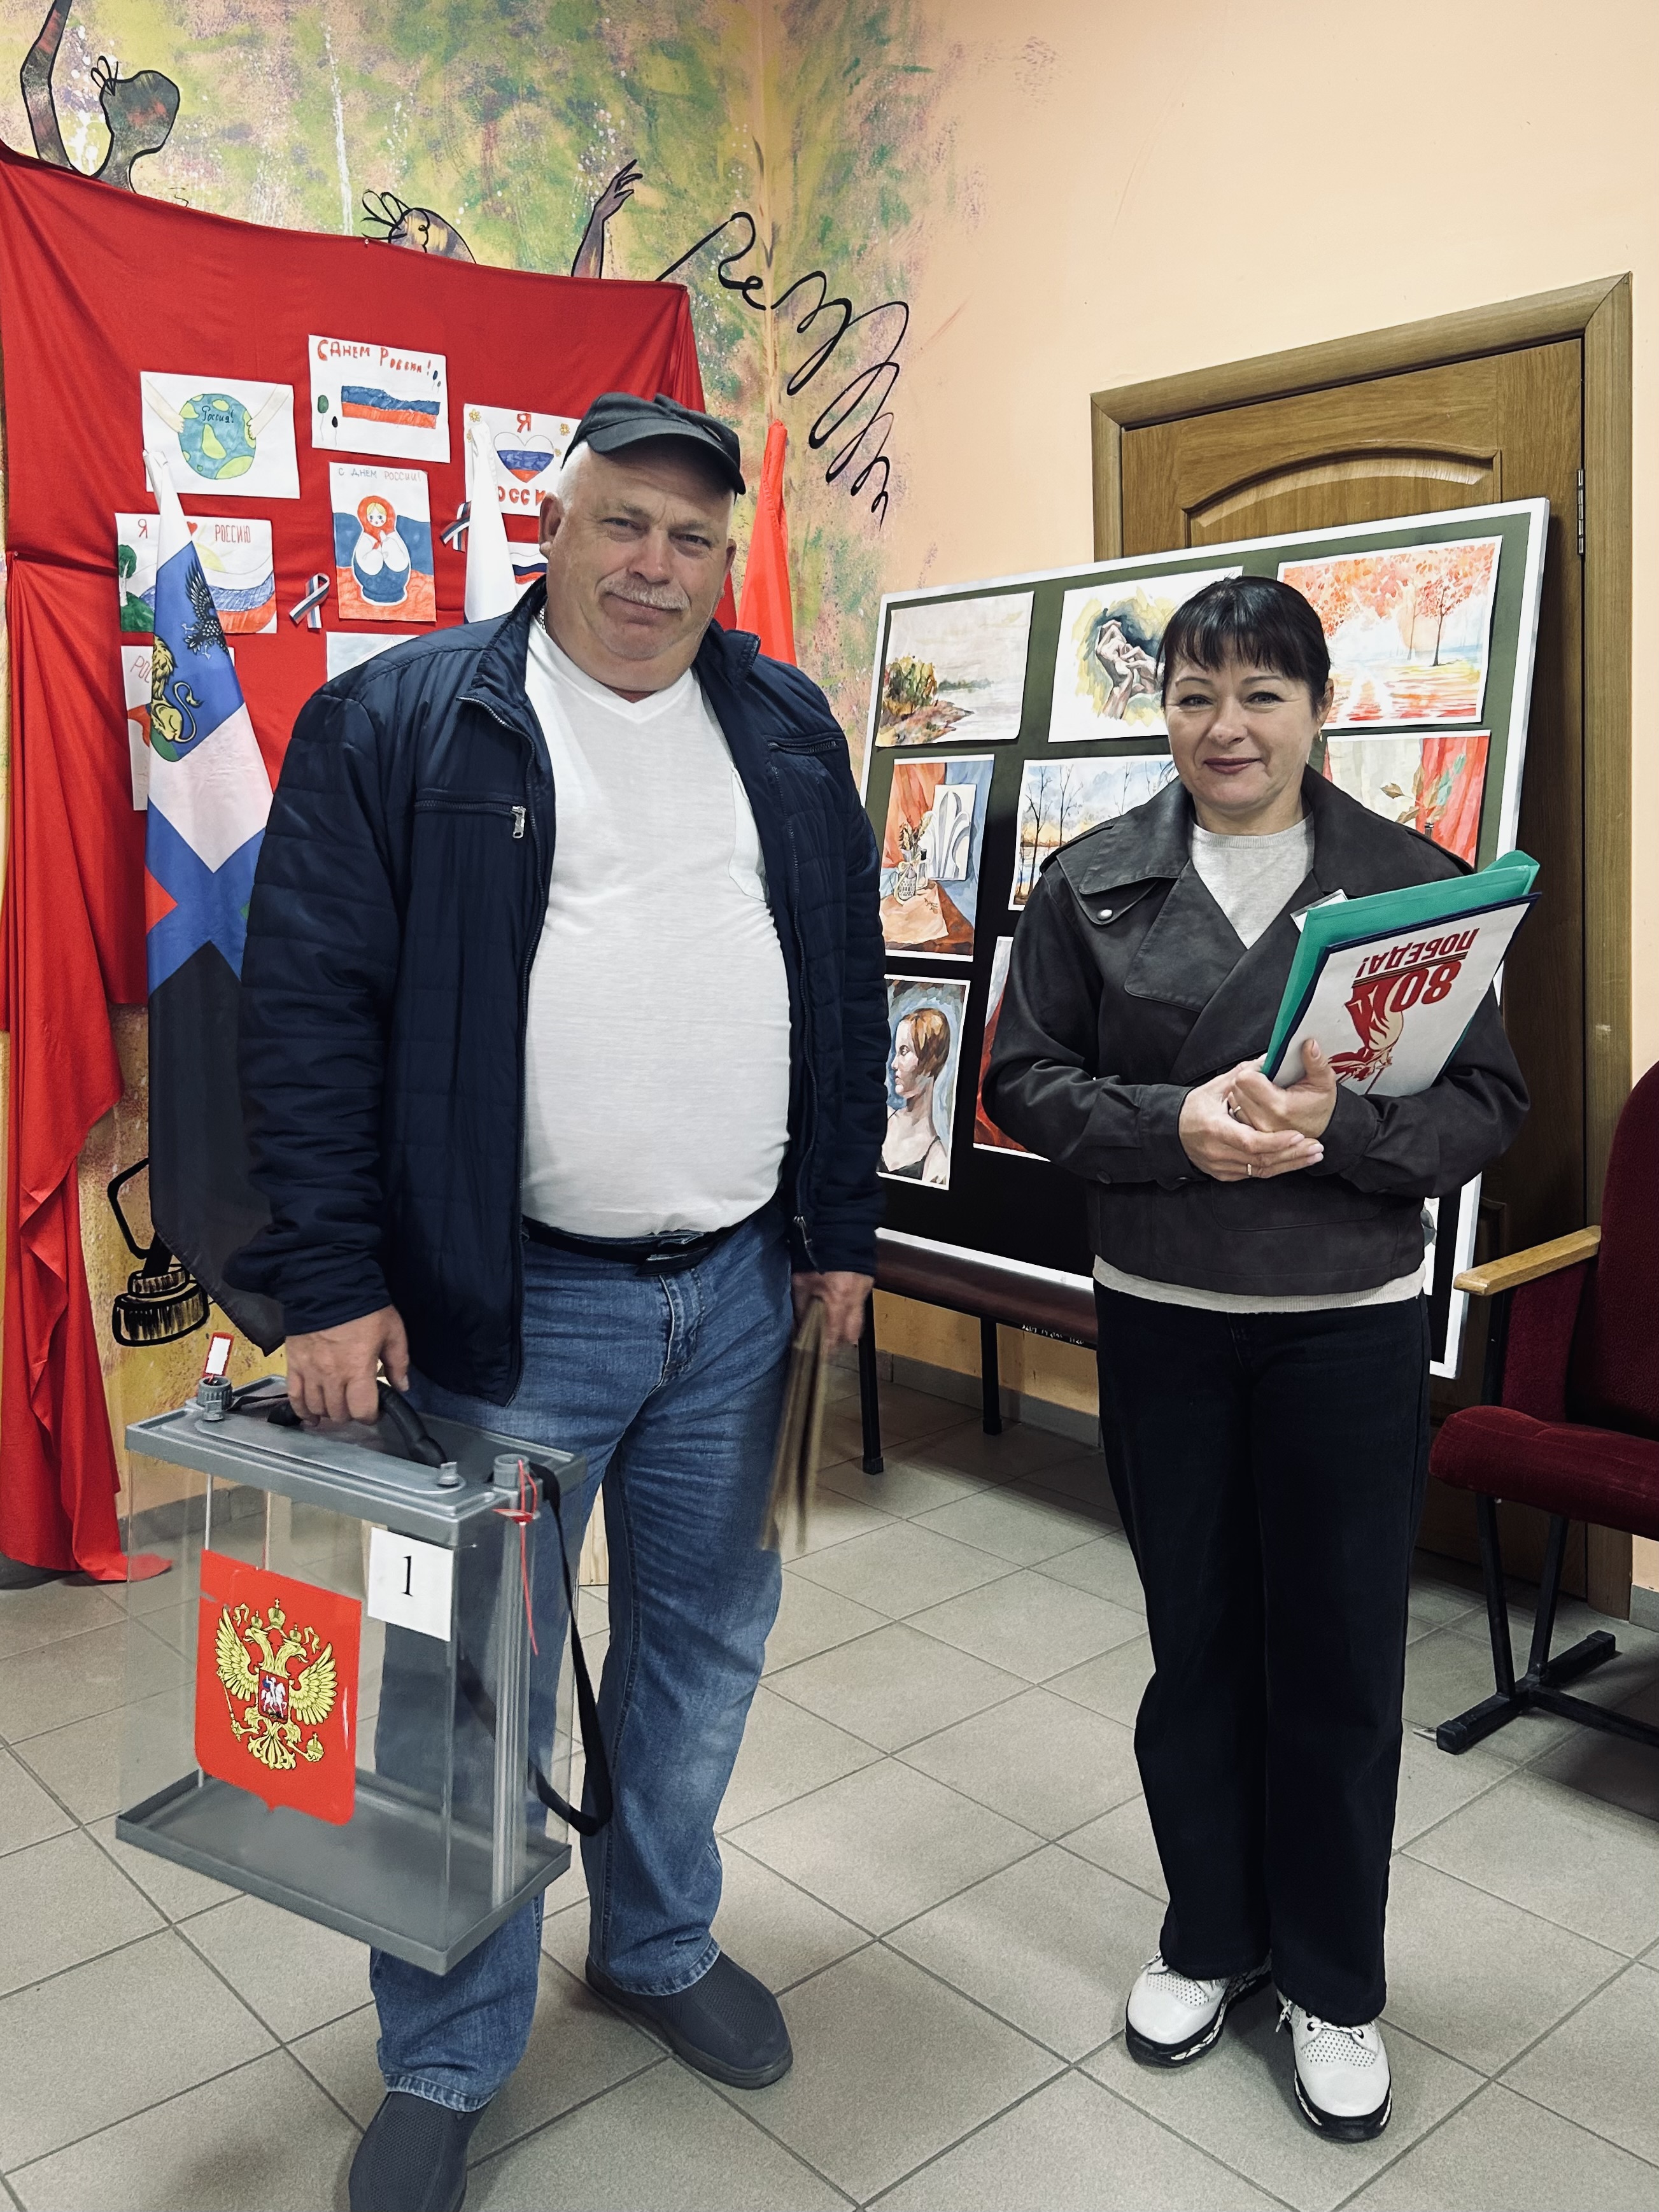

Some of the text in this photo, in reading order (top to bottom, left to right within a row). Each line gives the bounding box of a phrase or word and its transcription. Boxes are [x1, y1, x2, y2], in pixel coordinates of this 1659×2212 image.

[517, 413, 532, 433] Я
[338, 467, 344, 476] С
[138, 518, 251, 544] Я РОССИЮ
[1355, 927, 1480, 978] ПОБЕДА!
[1389, 960, 1462, 1013] 80
[401, 1555, 414, 1597] 1
